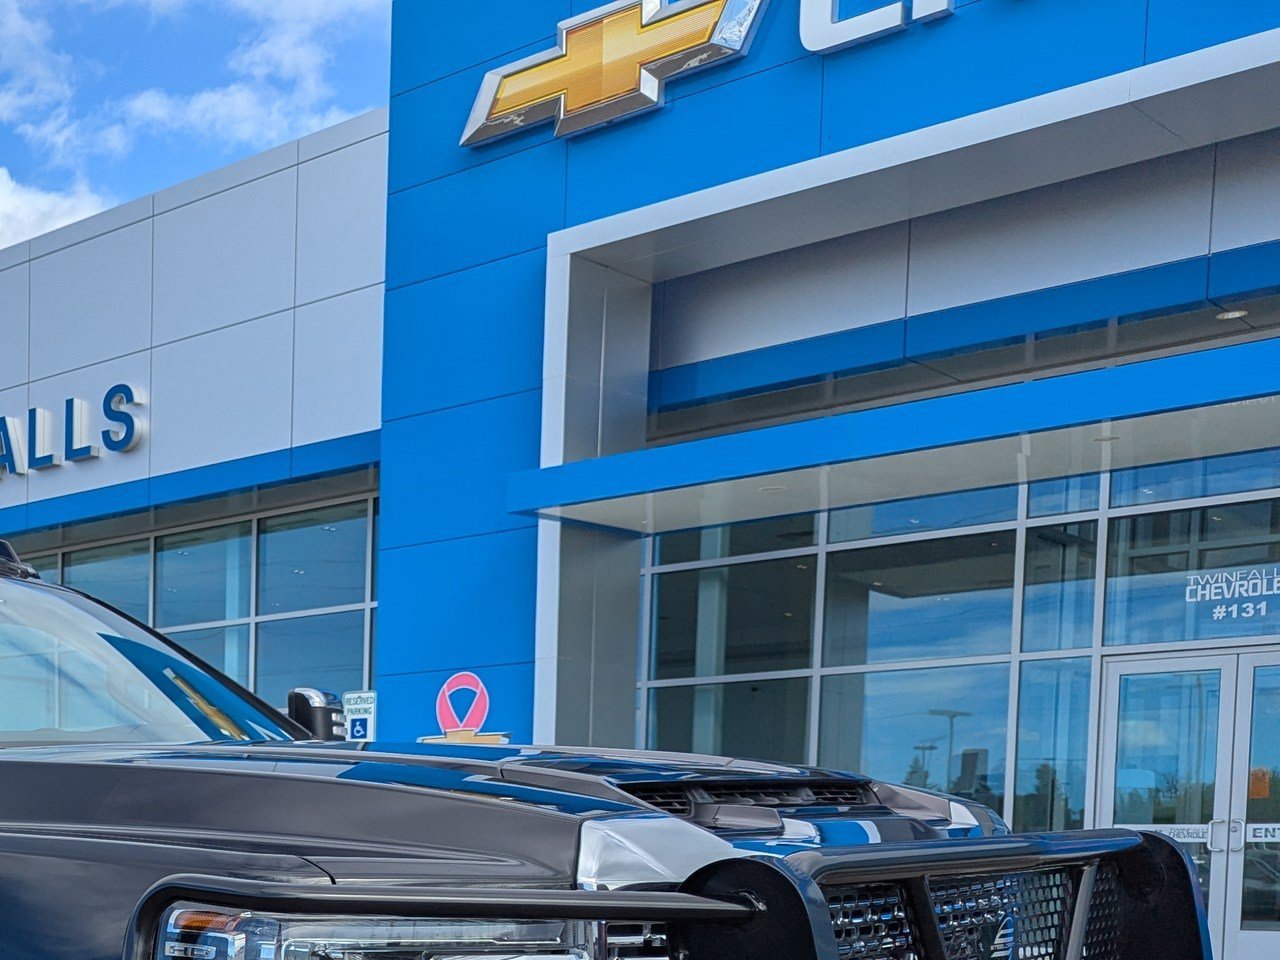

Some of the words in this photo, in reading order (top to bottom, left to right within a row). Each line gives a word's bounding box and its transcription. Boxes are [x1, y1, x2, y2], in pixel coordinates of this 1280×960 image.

[1212, 601, 1267, 620] #131
[345, 695, 374, 706] RESERVED
[347, 706, 372, 716] PARKING
